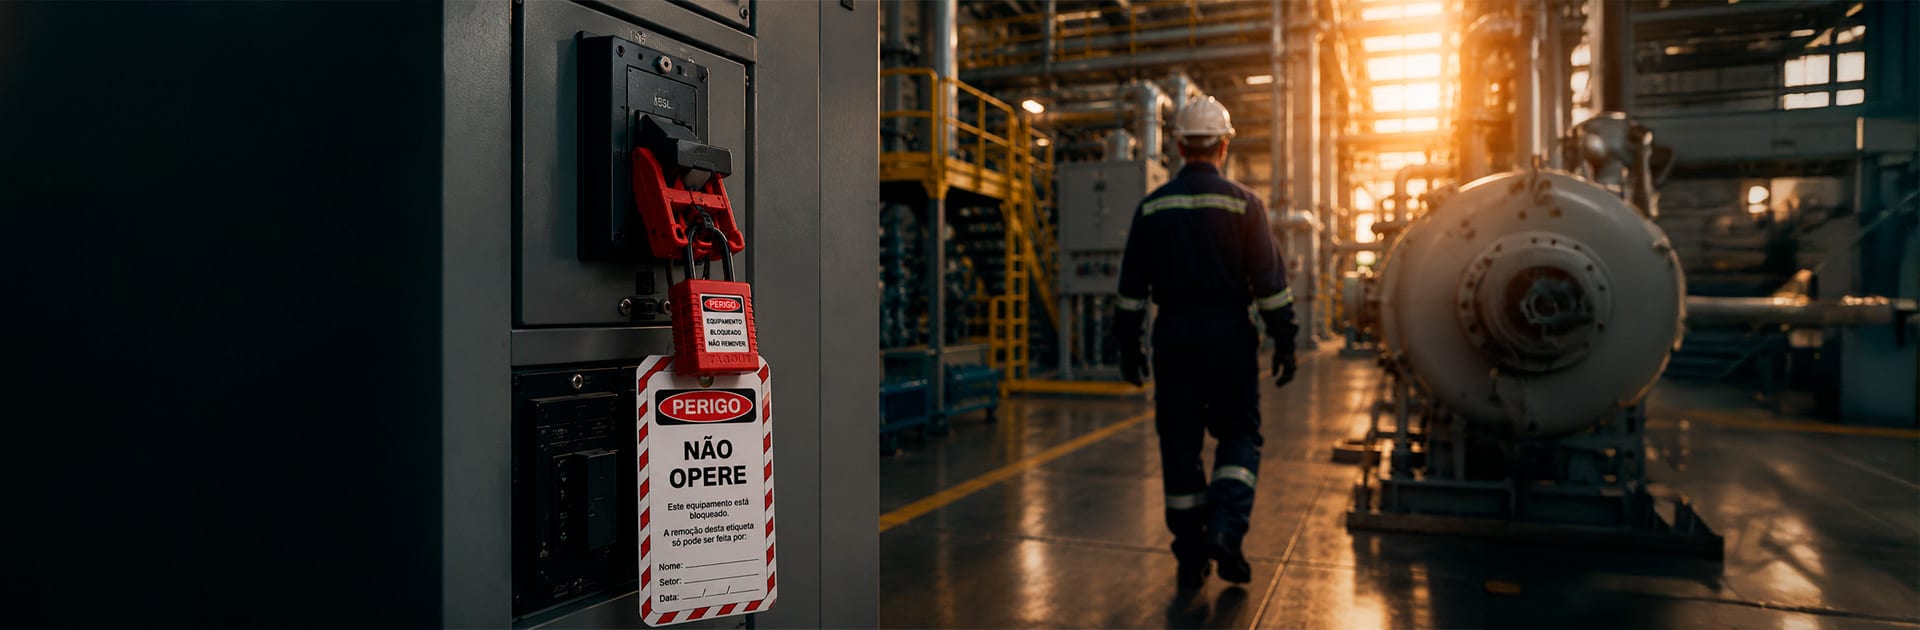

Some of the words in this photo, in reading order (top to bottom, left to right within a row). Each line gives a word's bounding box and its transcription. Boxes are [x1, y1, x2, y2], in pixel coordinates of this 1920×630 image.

[709, 300, 736, 309] PERIGO
[708, 339, 720, 347] NÃO
[672, 398, 741, 415] PERIGO
[684, 435, 733, 460] NÃO
[669, 465, 747, 488] OPERE
[667, 503, 684, 511] Este
[686, 500, 732, 511] equipamento
[734, 498, 749, 506] está
[690, 510, 729, 520] bloqueado.
[664, 529, 669, 537] A
[671, 527, 703, 537] remoção
[705, 525, 724, 533] desta
[726, 522, 754, 533] etiqueta
[672, 539, 681, 547] só
[683, 537, 702, 547] pode
[716, 534, 731, 542] feita
[733, 533, 747, 542] por:
[659, 563, 683, 571] Nome:
[659, 578, 682, 586] Setor:
[660, 594, 679, 603] Data:
